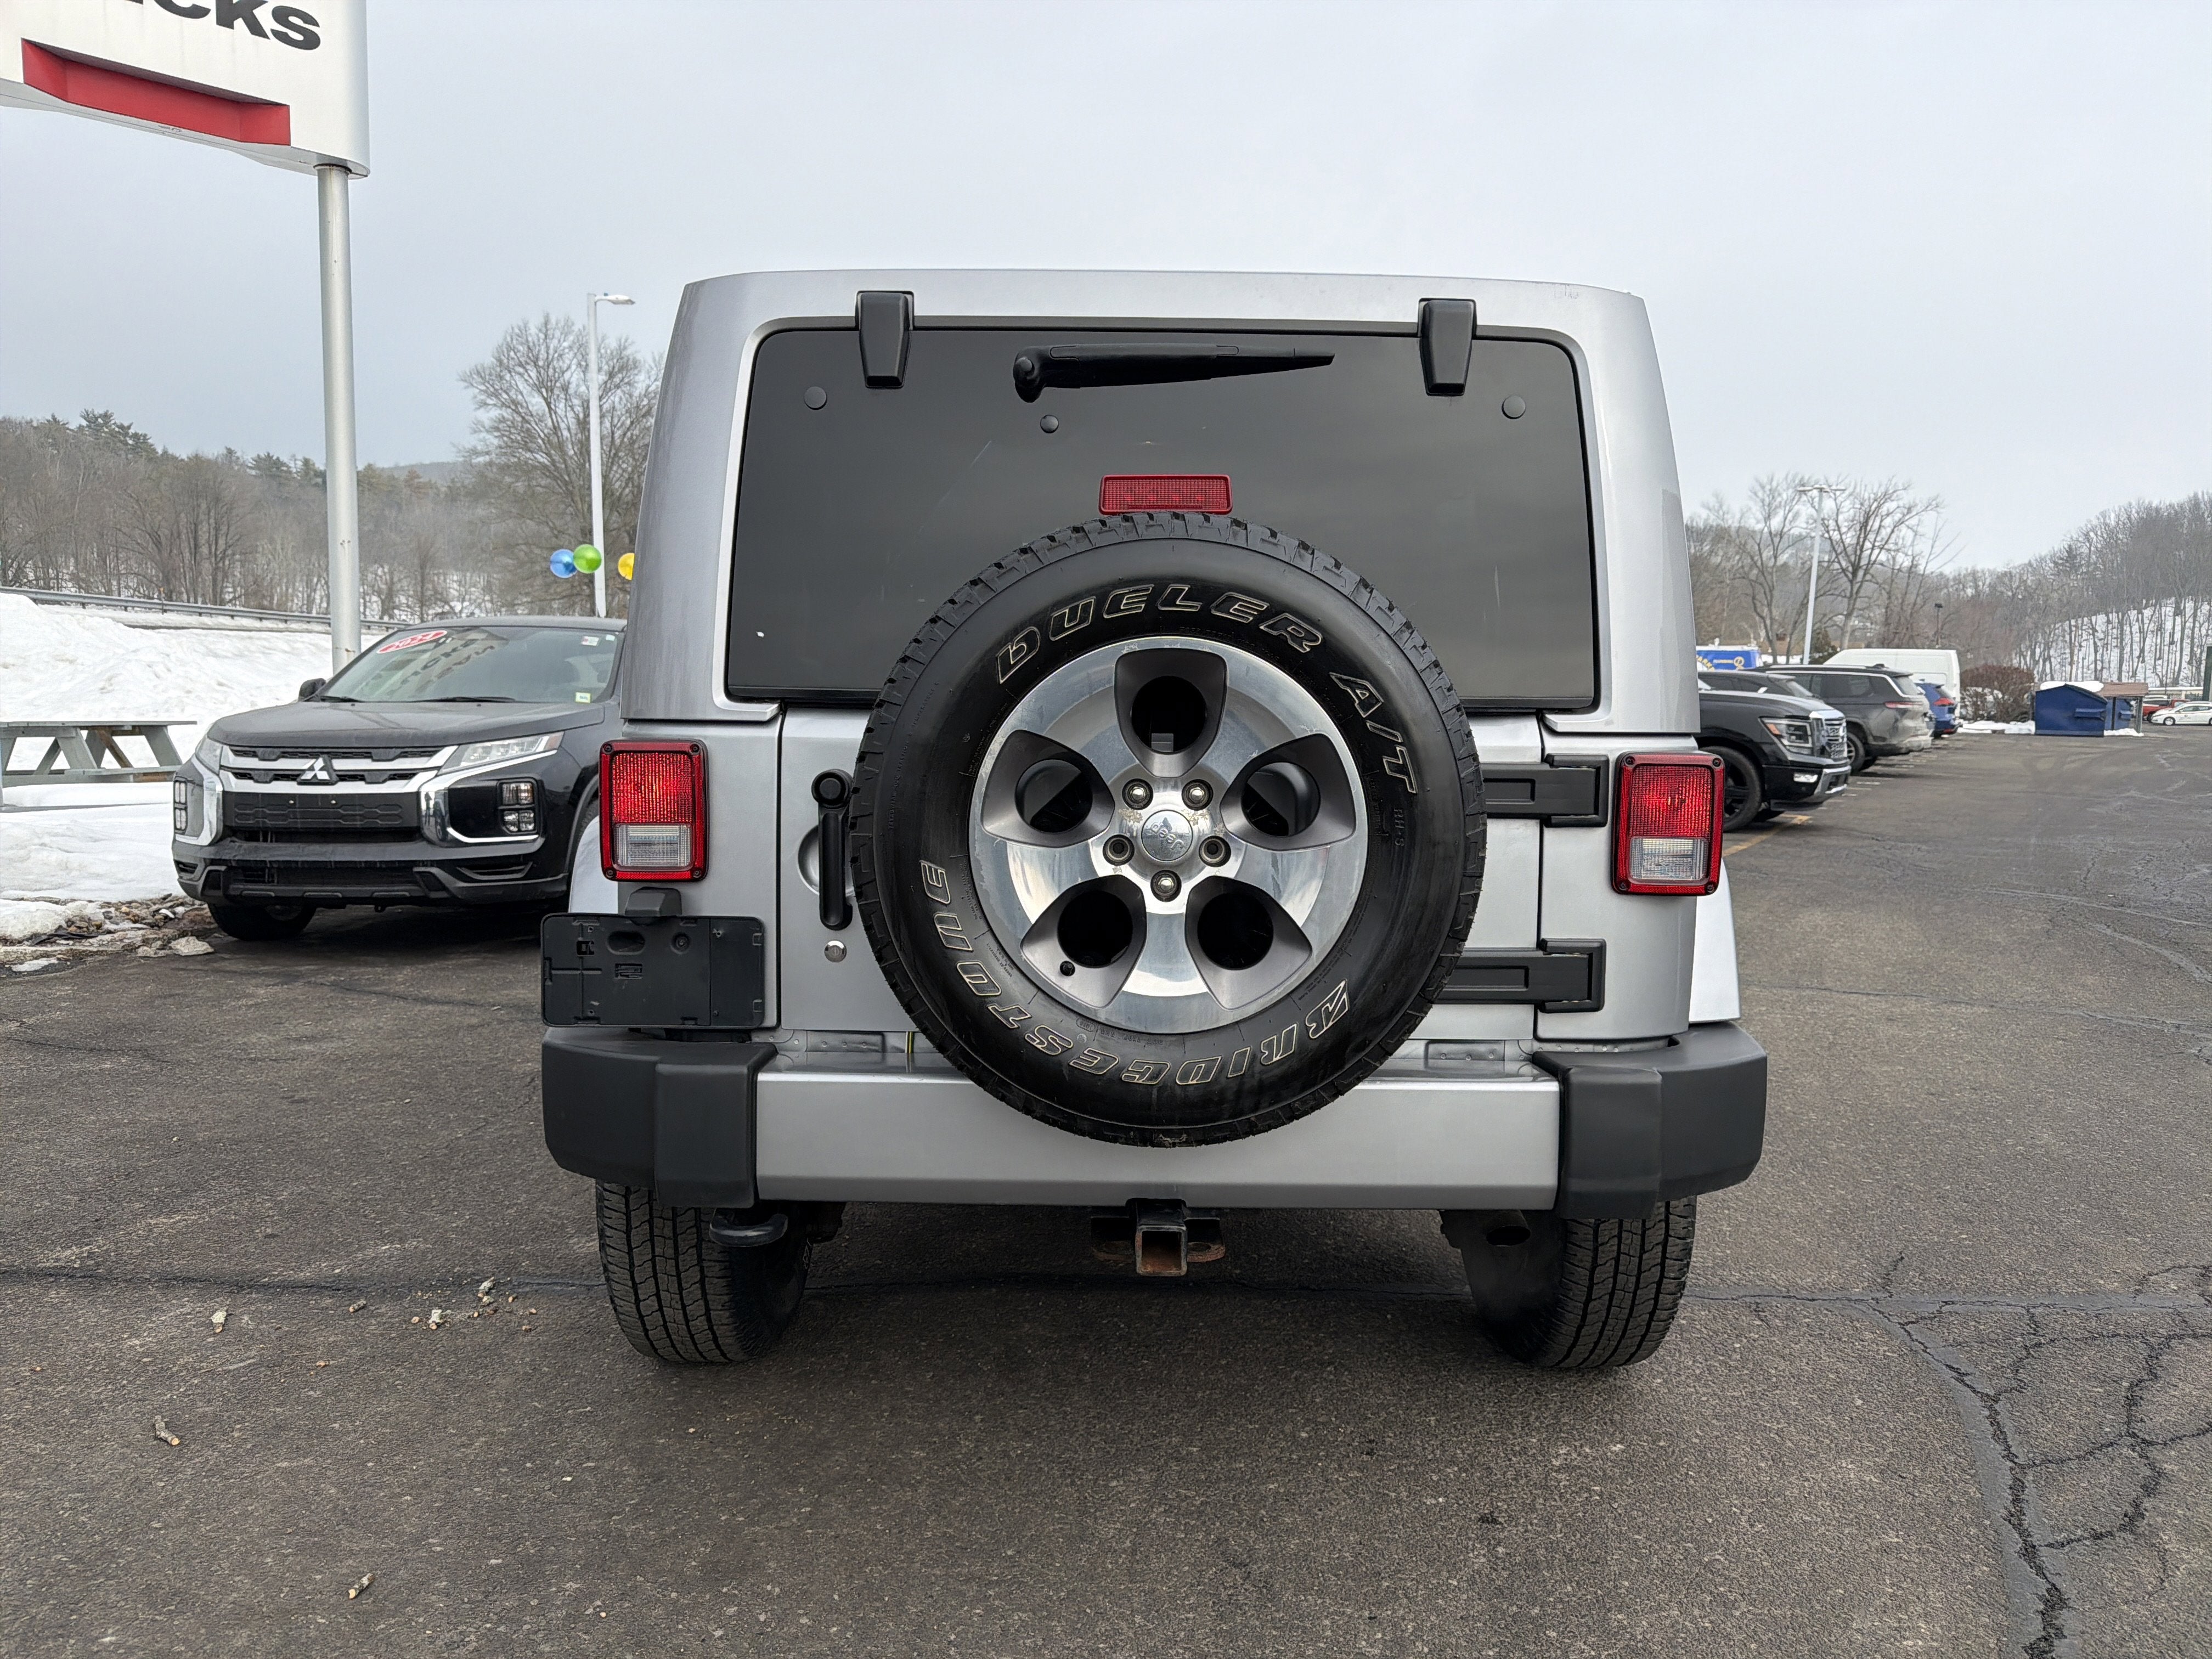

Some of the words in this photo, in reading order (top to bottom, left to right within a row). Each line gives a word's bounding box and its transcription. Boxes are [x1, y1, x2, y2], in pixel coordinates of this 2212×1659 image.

[126, 0, 321, 50] cks
[996, 584, 1323, 684] DUELER
[1329, 672, 1418, 794] A/T
[1150, 822, 1184, 851] Jeep
[919, 860, 1350, 1085] BRIDGESTONE
